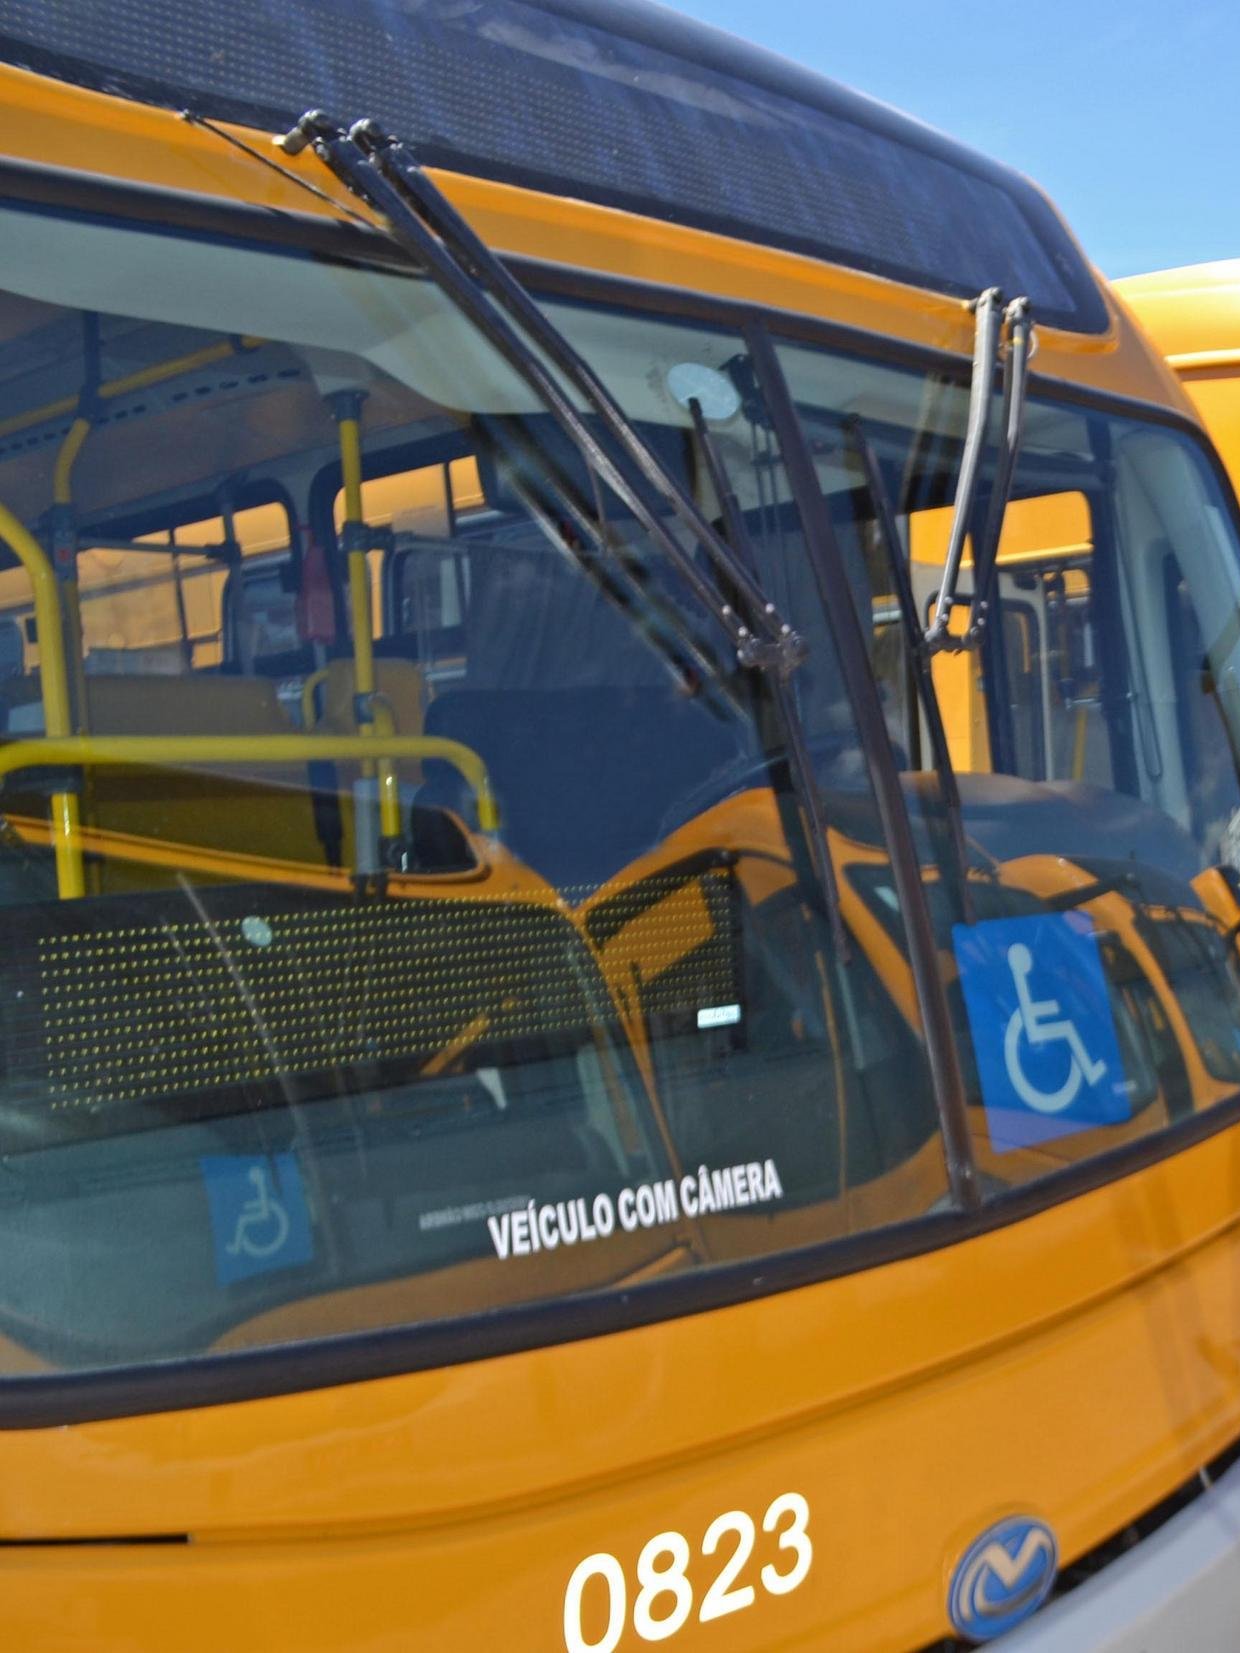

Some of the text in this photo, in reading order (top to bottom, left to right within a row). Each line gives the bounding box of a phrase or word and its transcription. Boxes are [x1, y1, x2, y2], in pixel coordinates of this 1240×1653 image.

[487, 1193, 614, 1260] VEÍCULO
[617, 1179, 680, 1232] COM
[679, 1158, 783, 1218] CÂMERA
[564, 1492, 813, 1653] 0823
